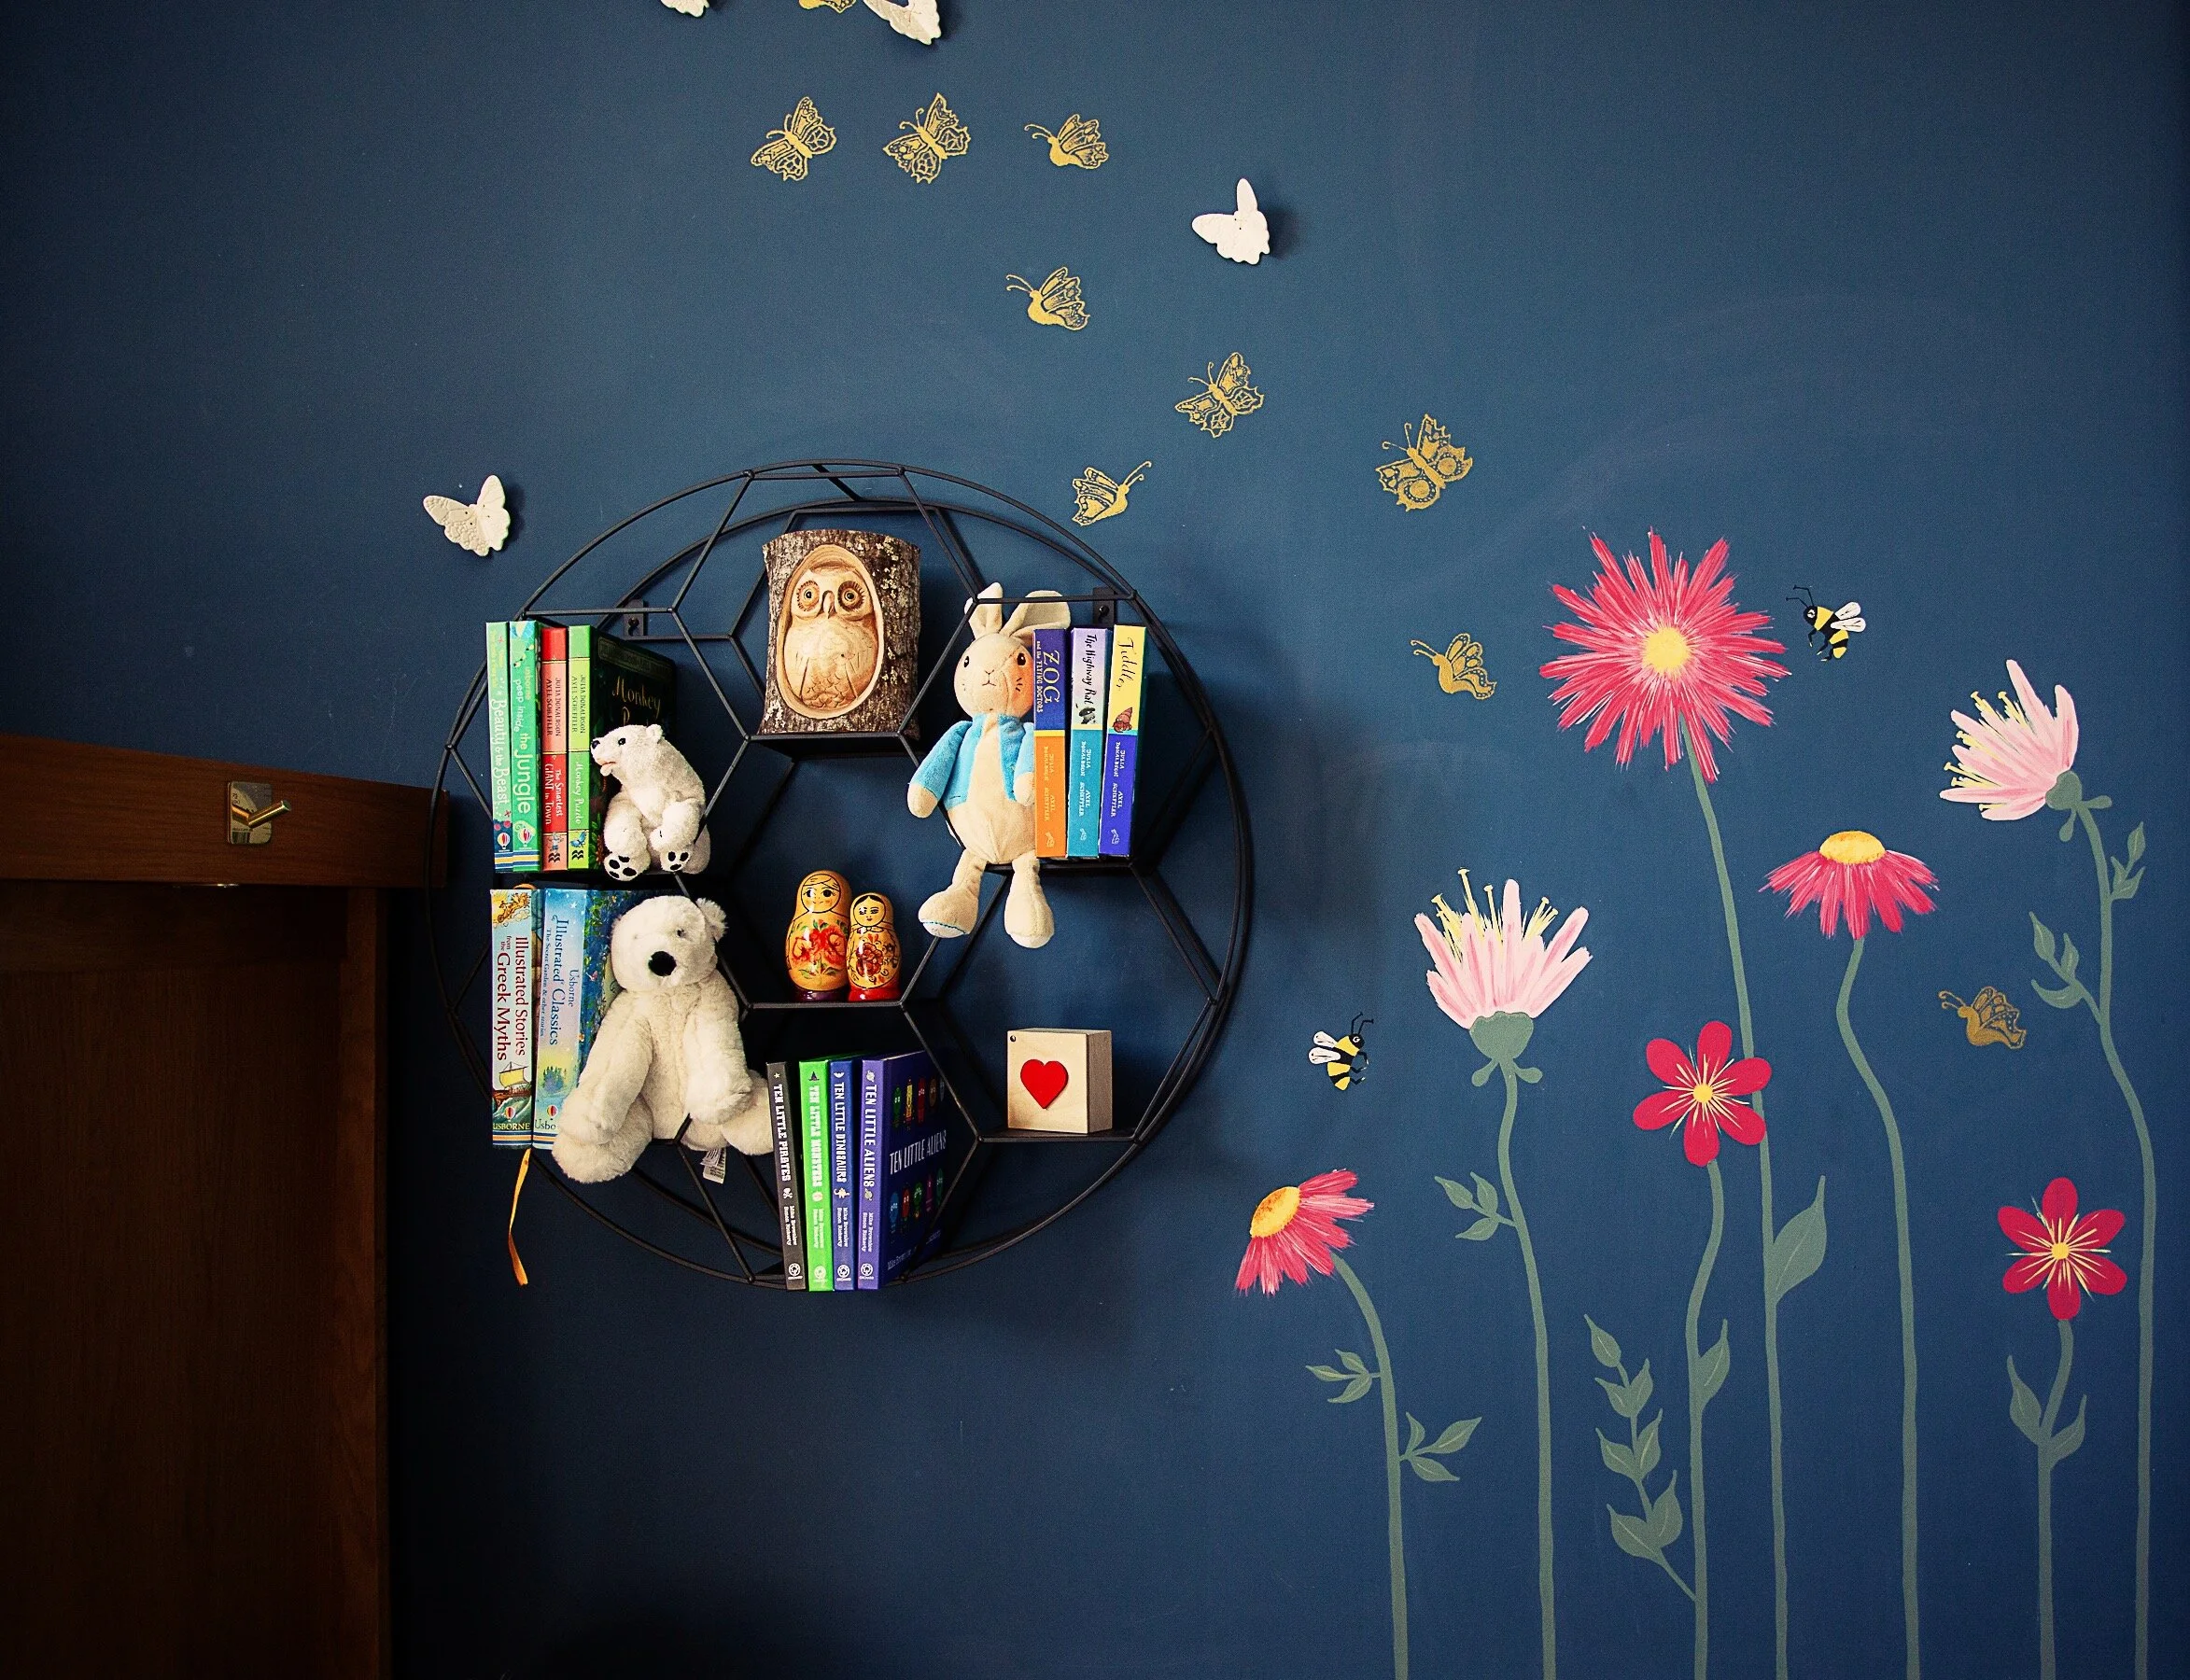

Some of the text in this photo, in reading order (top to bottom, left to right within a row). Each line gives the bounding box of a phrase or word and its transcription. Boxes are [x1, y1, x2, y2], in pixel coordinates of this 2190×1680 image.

[1043, 650, 1060, 704] ZOG
[1082, 634, 1098, 704] The Highway Rat
[1116, 637, 1137, 690] Tiddler
[512, 679, 525, 703] peep
[612, 676, 661, 721] Monkey
[490, 699, 508, 744] Beauty
[513, 706, 526, 732] inside
[520, 733, 530, 749] the
[496, 754, 504, 765] the
[544, 763, 554, 791] GIANT
[493, 767, 510, 805] Beast
[554, 769, 564, 816] The Smartest
[571, 762, 584, 824] Monkey Puzzle
[544, 801, 554, 824] Town
[515, 937, 528, 1056] Illustrated Stories
[550, 915, 569, 1045] Illustrated Classics
[568, 969, 579, 1007] Usborne
[494, 952, 512, 1060] Greek Myths
[535, 1119, 556, 1130] Usbo
[773, 1084, 792, 1182] TEN LITTLE PIRATES
[808, 1085, 822, 1187] TEN LITTLE MONSTERS
[834, 1082, 847, 1183] TEN LITTLE DINOSAURS
[863, 1085, 877, 1187] TEN LITTLE ALIENS
[890, 1129, 947, 1175] TEN LITTLE ALIENS
